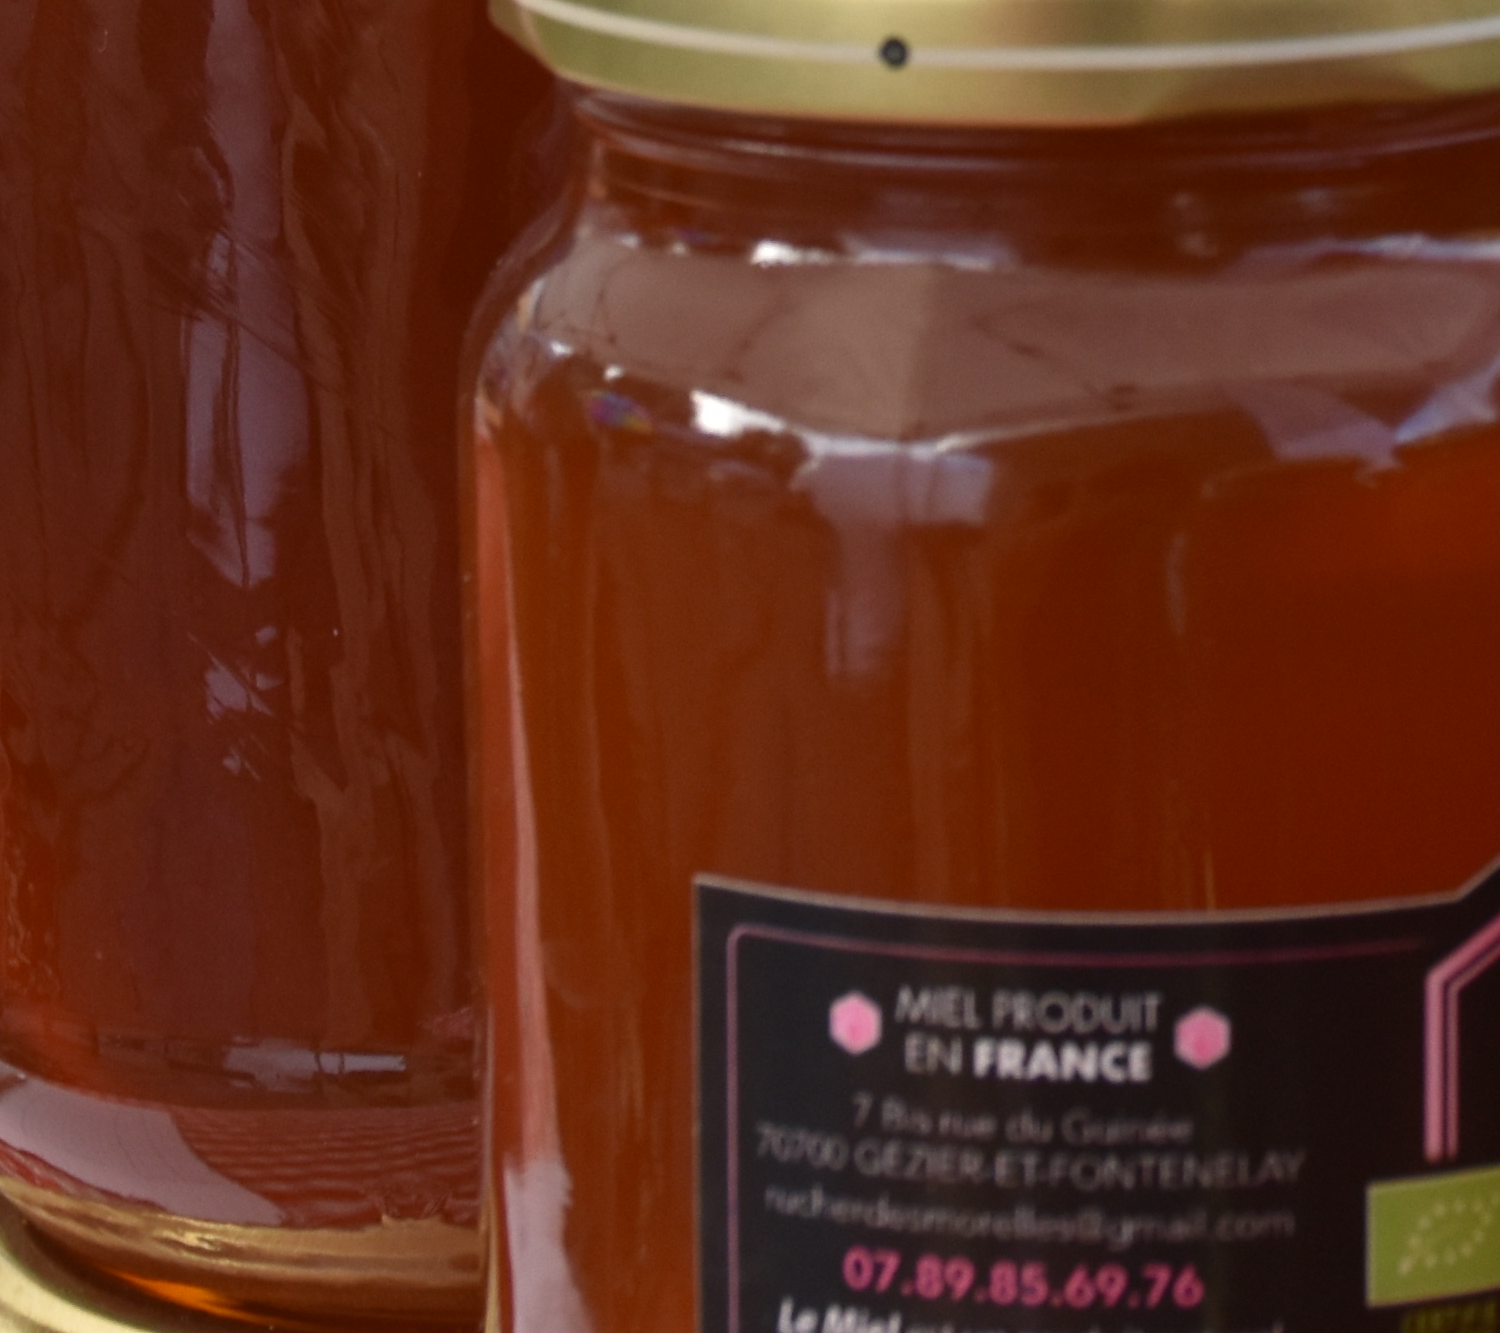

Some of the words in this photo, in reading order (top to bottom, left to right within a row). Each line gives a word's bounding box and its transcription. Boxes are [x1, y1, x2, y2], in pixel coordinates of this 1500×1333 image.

[895, 983, 982, 1030] MIEL
[991, 989, 1163, 1033] PRODUIT
[905, 1034, 963, 1075] EN
[972, 1040, 1154, 1083] FRANCE
[842, 1246, 1205, 1309] 07.89.85.69.76
